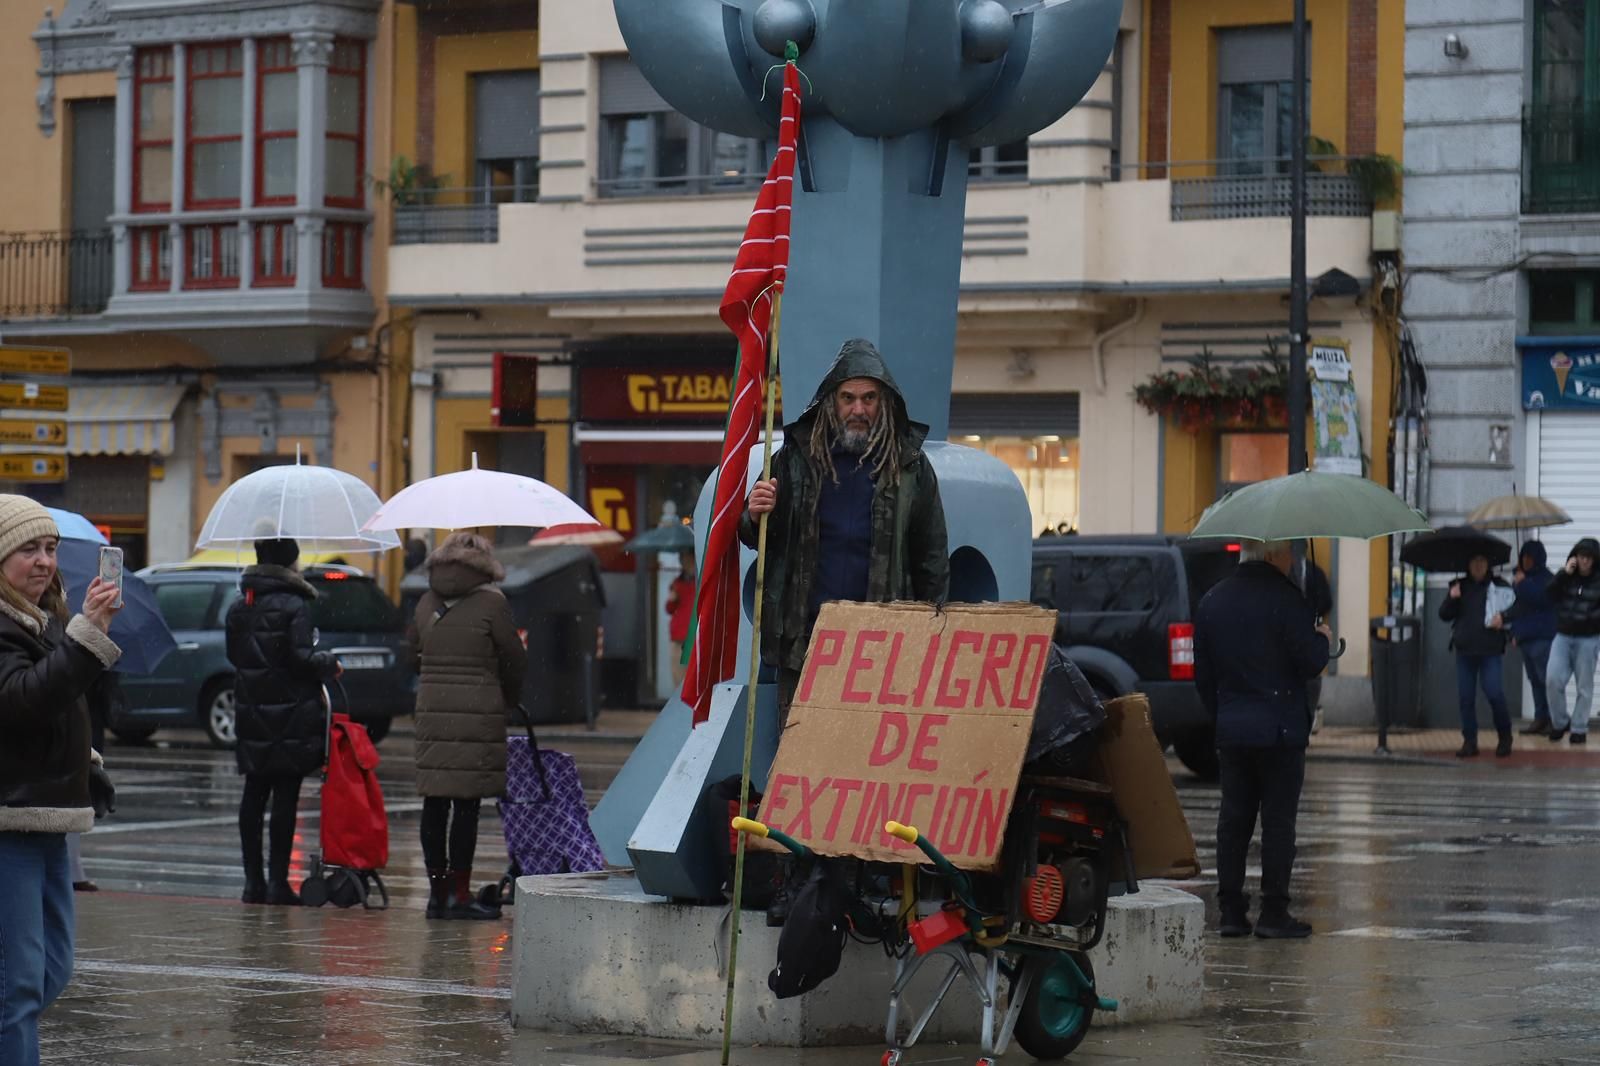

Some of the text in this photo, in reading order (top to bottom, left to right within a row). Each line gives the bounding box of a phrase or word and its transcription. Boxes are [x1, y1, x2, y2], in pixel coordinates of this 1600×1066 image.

[799, 629, 1050, 710] PELIGRO
[869, 711, 949, 771] DE
[762, 770, 1009, 857] EXTINCIÓN
